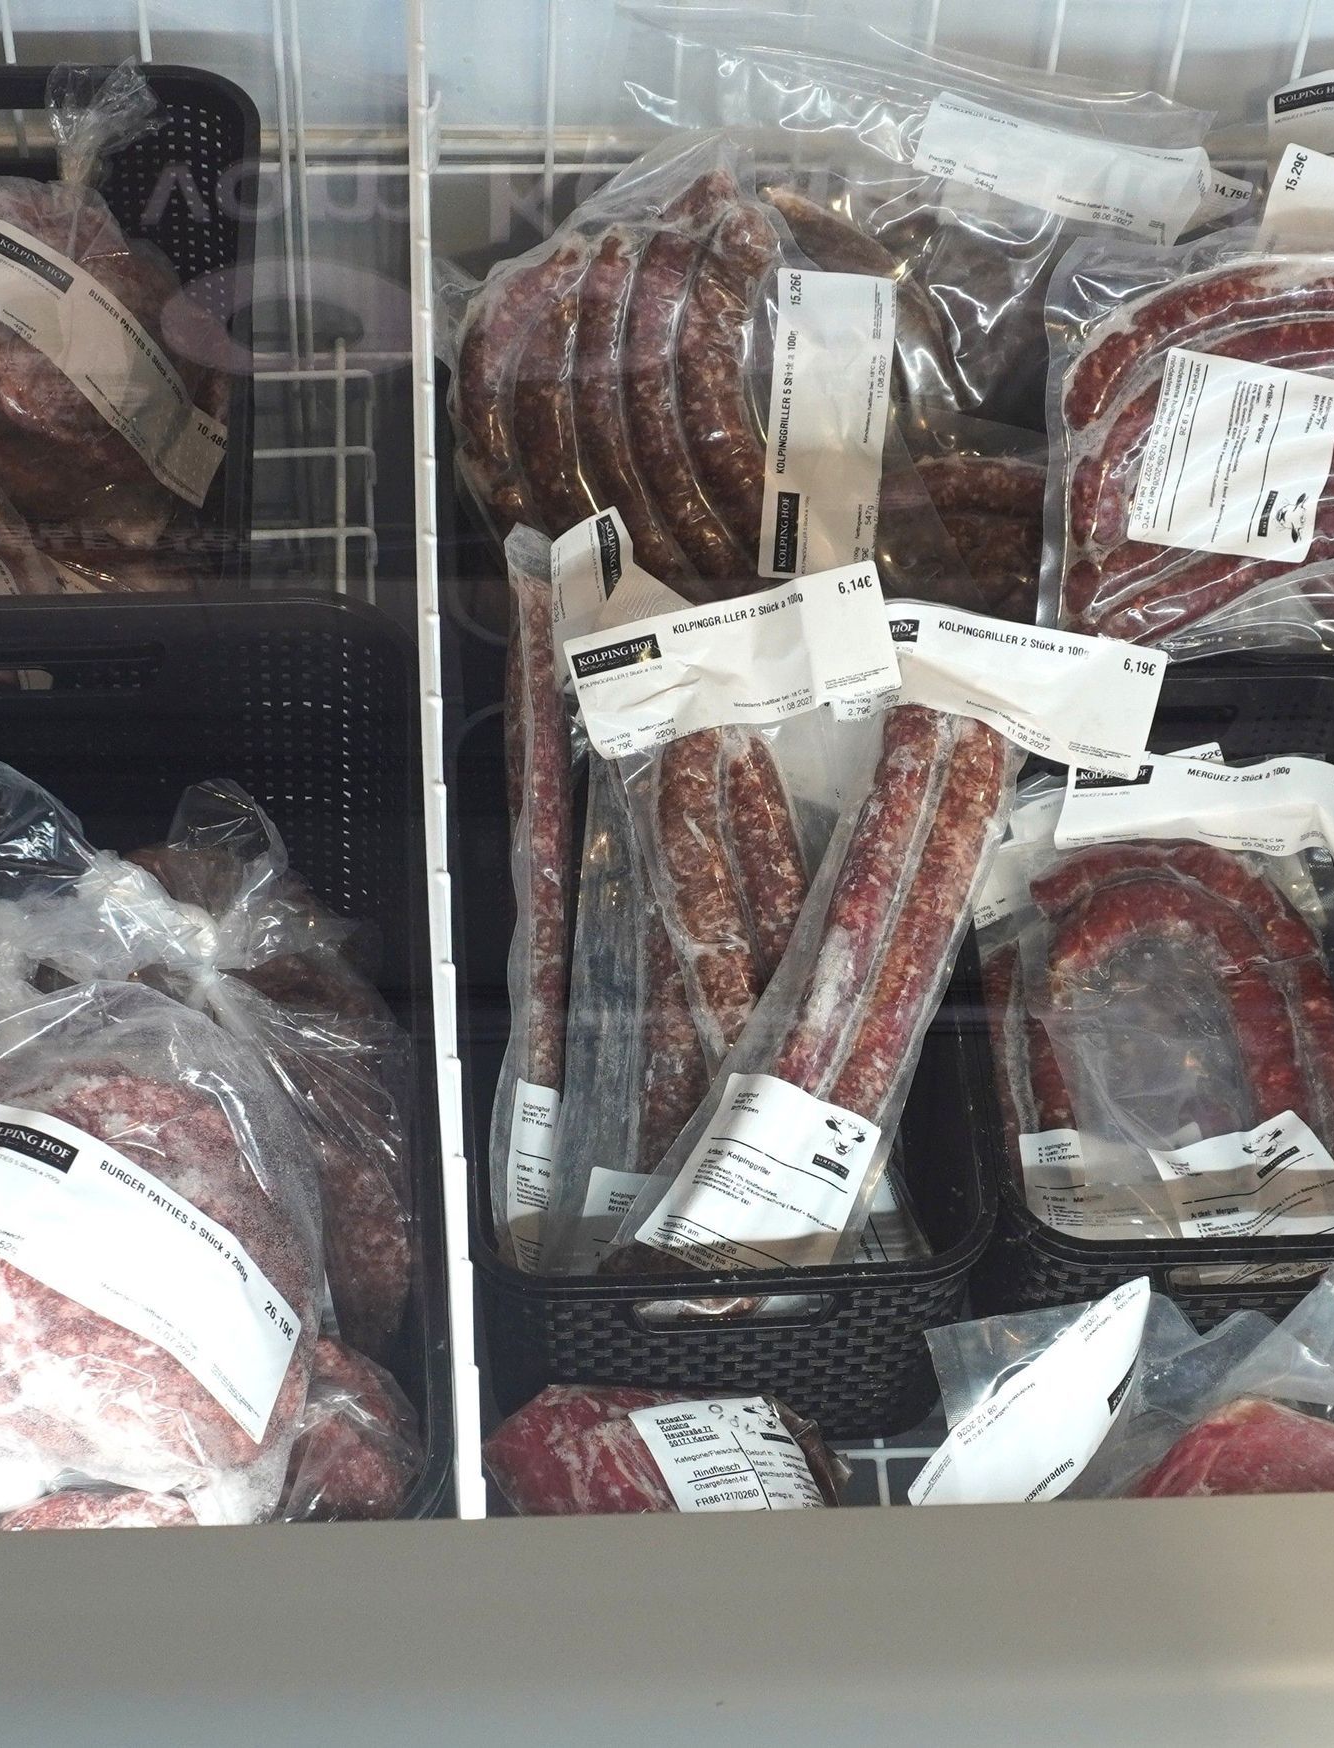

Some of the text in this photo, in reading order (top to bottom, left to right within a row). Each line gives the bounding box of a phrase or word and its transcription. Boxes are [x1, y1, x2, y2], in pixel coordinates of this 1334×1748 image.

[1278, 86, 1324, 105] KOLPING
[1285, 152, 1308, 192] 15,29€
[1215, 184, 1252, 199] 14,79€
[790, 273, 802, 305] 15,26€
[88, 288, 119, 320] BURGER
[120, 318, 145, 350] PATTIES
[145, 348, 151, 358] 5
[877, 355, 887, 399] 11.08.2027
[1163, 355, 1178, 396] mindestens
[1173, 357, 1187, 399] mindestens
[1190, 364, 1202, 395] verpackt
[1255, 383, 1275, 444] Artikel: Merguez
[776, 398, 791, 474] KOLPINGGRILLER
[1144, 440, 1158, 481] 01-09-2027
[1152, 444, 1167, 486] 02-09-2026
[1140, 486, 1148, 498] bei
[1149, 486, 1157, 498] bei
[865, 505, 874, 525] 547g
[604, 521, 616, 567] KOLPING
[778, 497, 790, 567] KOLPING HOF
[838, 574, 873, 596] 6,14€
[672, 610, 748, 634] KOLPINGGRLLER
[750, 608, 756, 617] 2
[758, 601, 779, 616] Stück
[781, 601, 786, 609] a
[890, 623, 915, 633] HOF
[938, 620, 1018, 645] KOLPINGGRILLER
[1021, 636, 1027, 646] 2
[1030, 638, 1055, 652] Stück
[1058, 644, 1064, 653] a
[578, 639, 654, 668] KOLPING HOF
[1123, 658, 1157, 677] 6,19€
[776, 696, 813, 714] 11.08.2027
[847, 705, 871, 716] 2,79€
[609, 727, 677, 755] 2,79€ 220g
[1007, 725, 1051, 751] 11.08.2027
[1187, 766, 1290, 782] MERGUEZ 2 Stück 100g
[38, 1136, 72, 1161] HOF
[1058, 1154, 1080, 1162] Kerpen
[727, 1150, 771, 1176] Kolpinggriller
[99, 1159, 249, 1284] BURGER PATTIES 5 Stück a 200g
[1216, 1207, 1239, 1215] Merguez
[687, 1228, 737, 1255] am: 11.8.26
[690, 1244, 715, 1261] haltbar
[685, 1250, 709, 1266] haltbar
[263, 1300, 295, 1343] 26,19€
[660, 1422, 690, 1432] Kolping
[664, 1428, 702, 1440] Neustraße
[957, 1405, 998, 1440] 08.12.2026
[669, 1433, 720, 1447] 50171 Kerpen
[693, 1463, 740, 1479] Rindfleisch
[696, 1489, 759, 1507] FR8612170260
